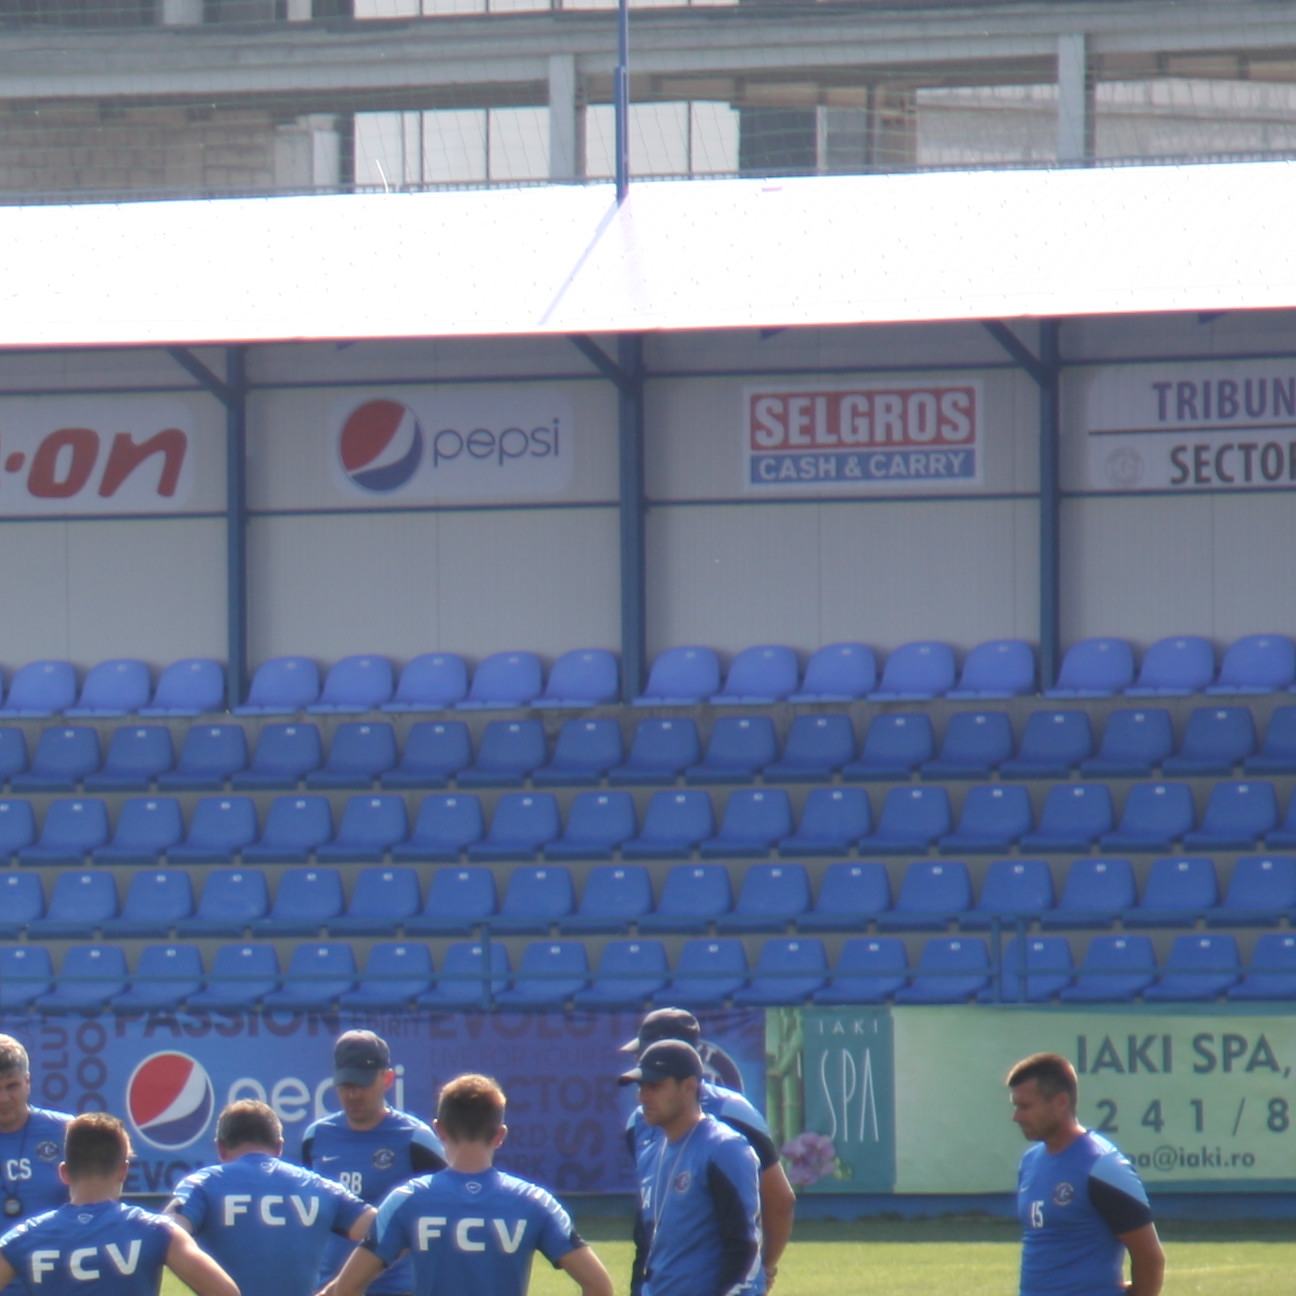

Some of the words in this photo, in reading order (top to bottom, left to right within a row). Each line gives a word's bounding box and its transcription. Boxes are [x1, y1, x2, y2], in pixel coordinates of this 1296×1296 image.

[754, 390, 971, 447] SELGROS
[433, 417, 561, 468] pepsi
[759, 456, 837, 481] CASH
[844, 455, 863, 479] &
[868, 452, 966, 477] CARRY
[818, 1019, 878, 1034] IAKI
[1076, 1034, 1172, 1074] IAKI
[1192, 1033, 1292, 1079] SPA,
[820, 1047, 879, 1142] SPA
[7, 1158, 32, 1182] CS
[223, 1194, 320, 1227] FCV
[417, 1216, 528, 1253] FCV
[31, 1239, 143, 1284] FCV
